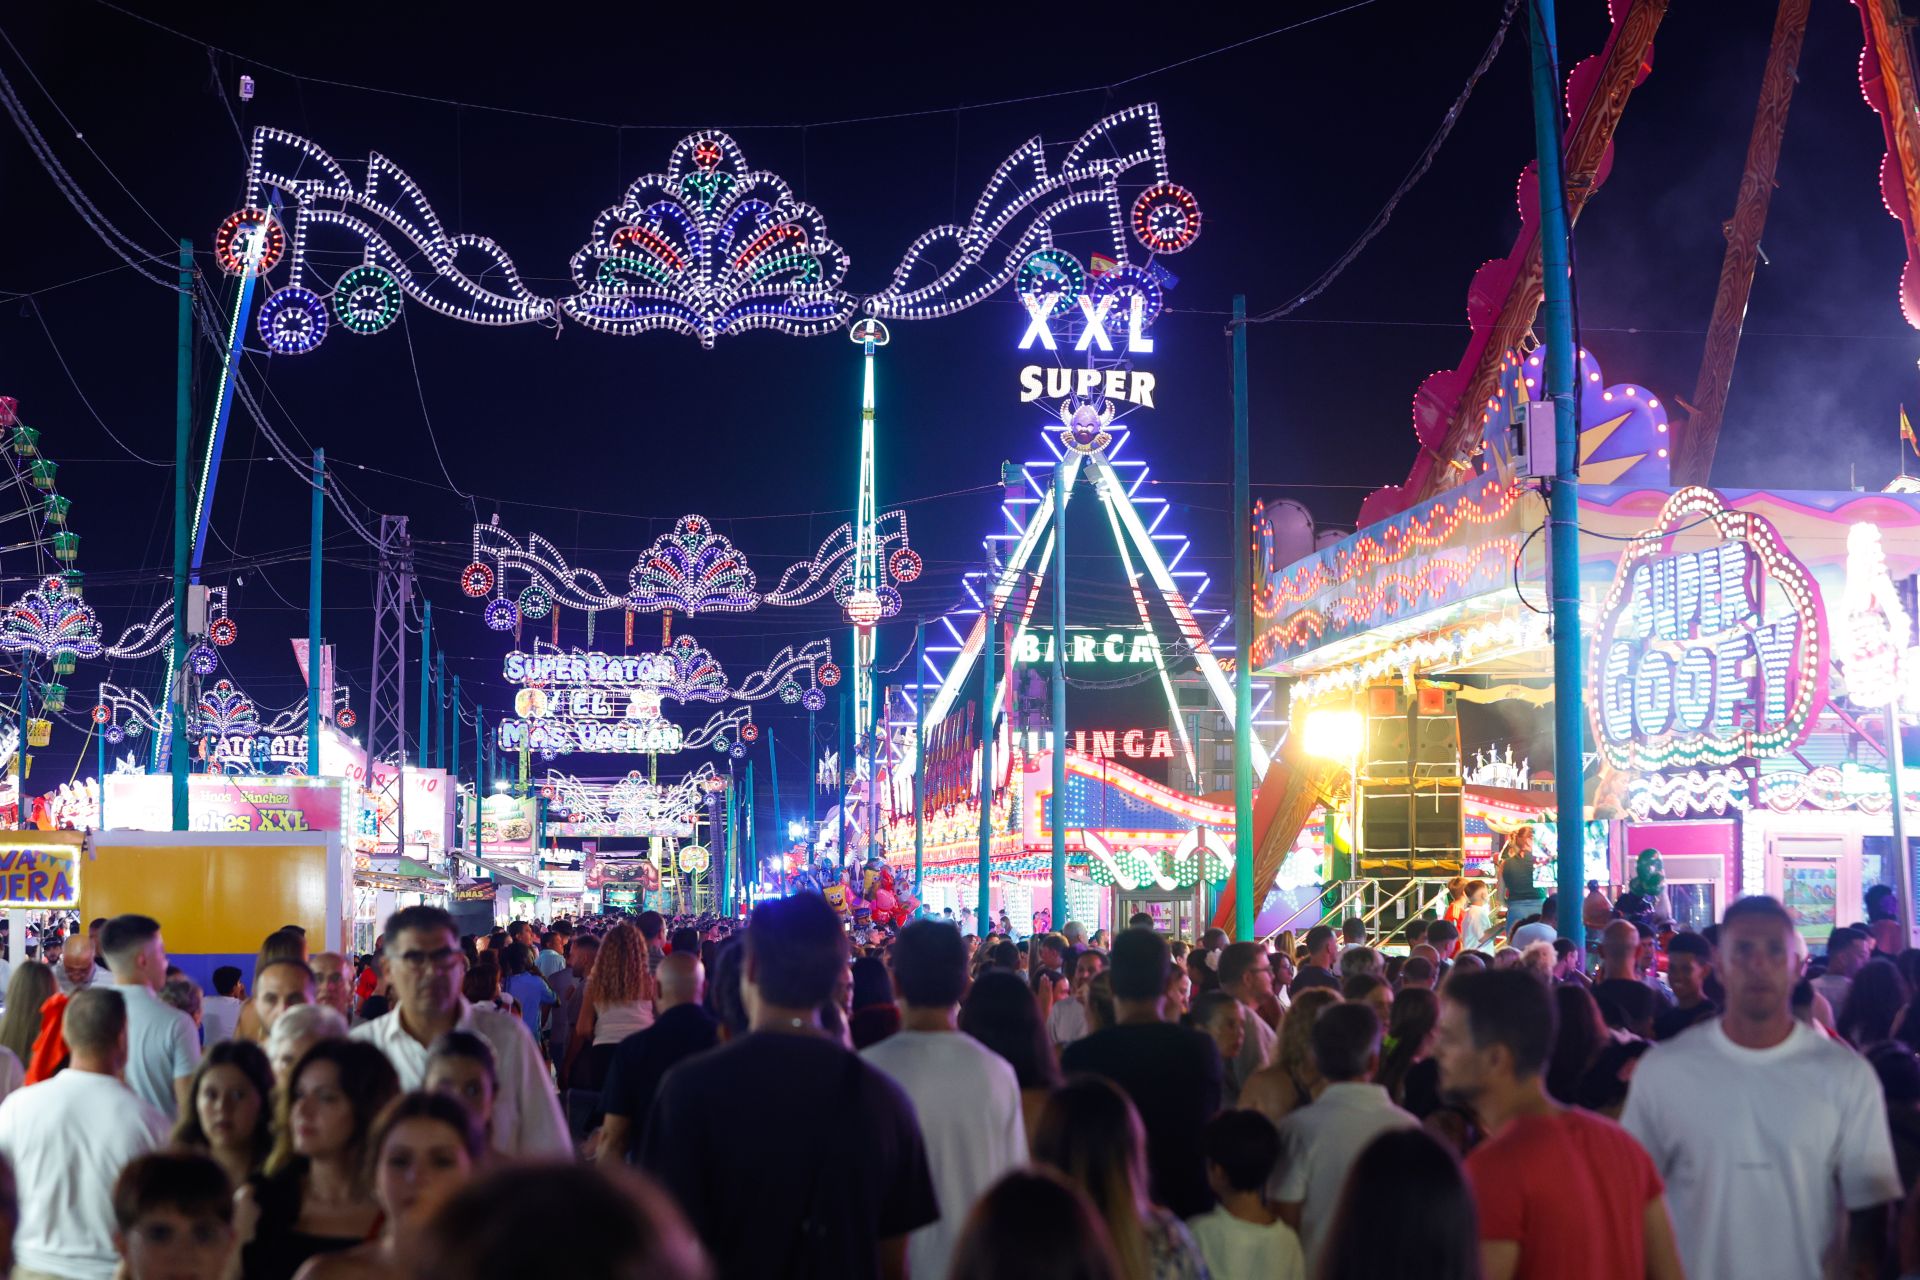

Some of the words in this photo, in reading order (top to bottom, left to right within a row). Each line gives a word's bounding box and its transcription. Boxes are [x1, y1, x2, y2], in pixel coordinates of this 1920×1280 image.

[1018, 292, 1154, 353] XXL
[1019, 364, 1156, 410] SUPER
[1631, 541, 1751, 641] SUPER
[1603, 612, 1799, 743] GOOFY
[239, 790, 290, 804] Sánchez
[258, 808, 309, 832] XXL
